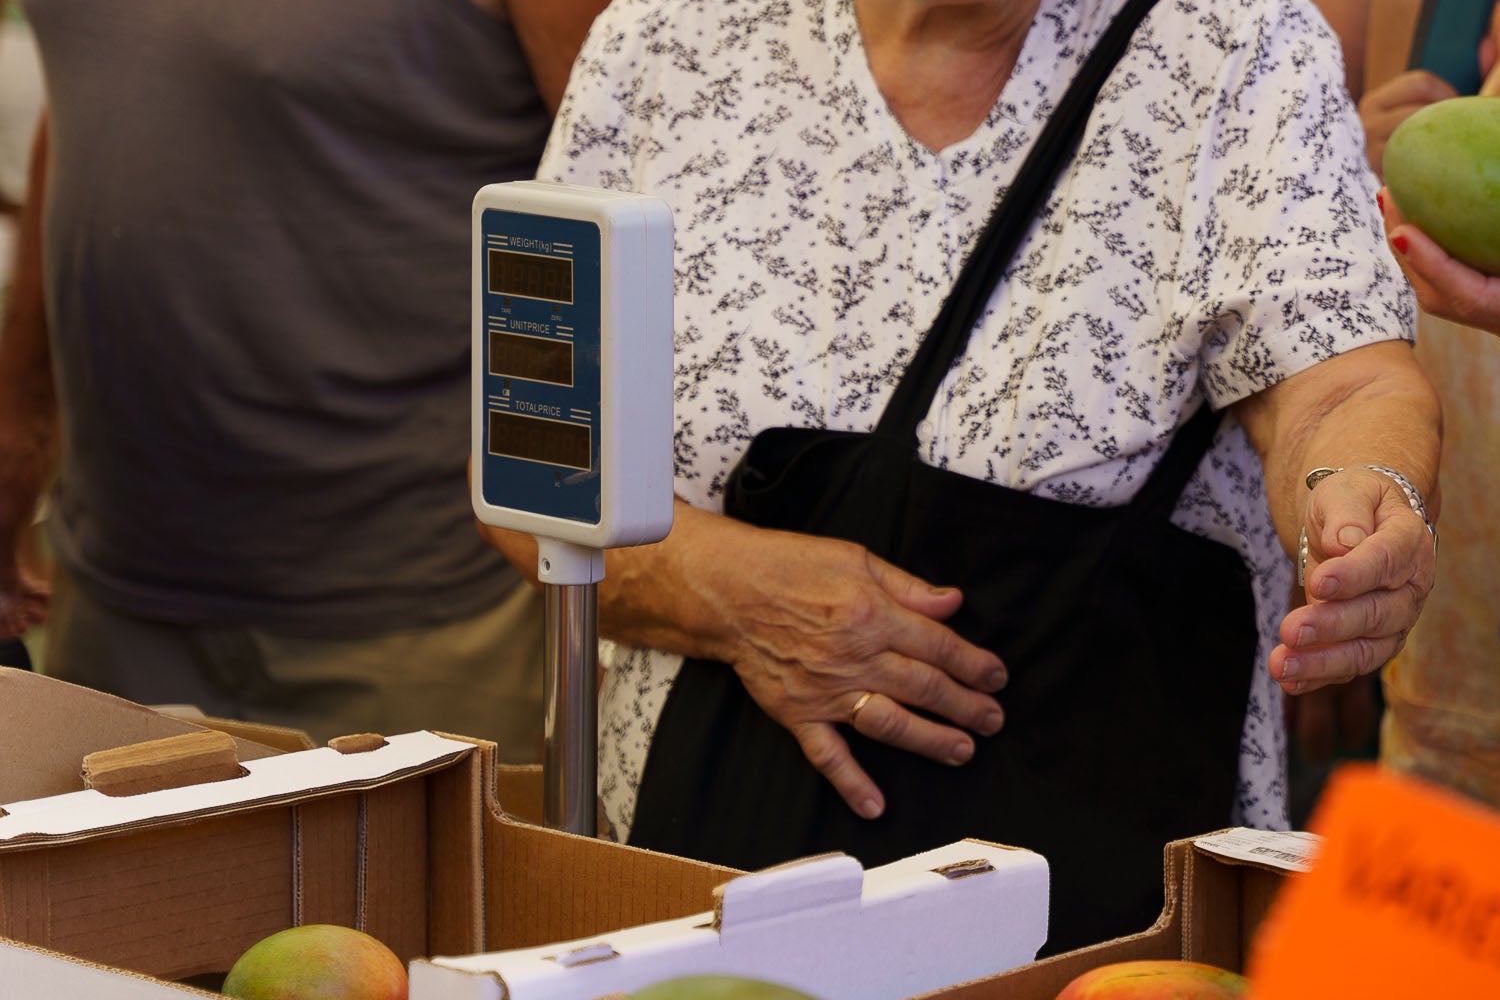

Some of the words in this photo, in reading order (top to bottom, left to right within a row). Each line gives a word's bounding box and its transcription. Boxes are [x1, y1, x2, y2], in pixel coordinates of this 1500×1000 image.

[509, 236, 552, 253] WEIGHT(kg)
[510, 319, 551, 334] UNITPRICE
[515, 400, 561, 417] TOTALPRICE
